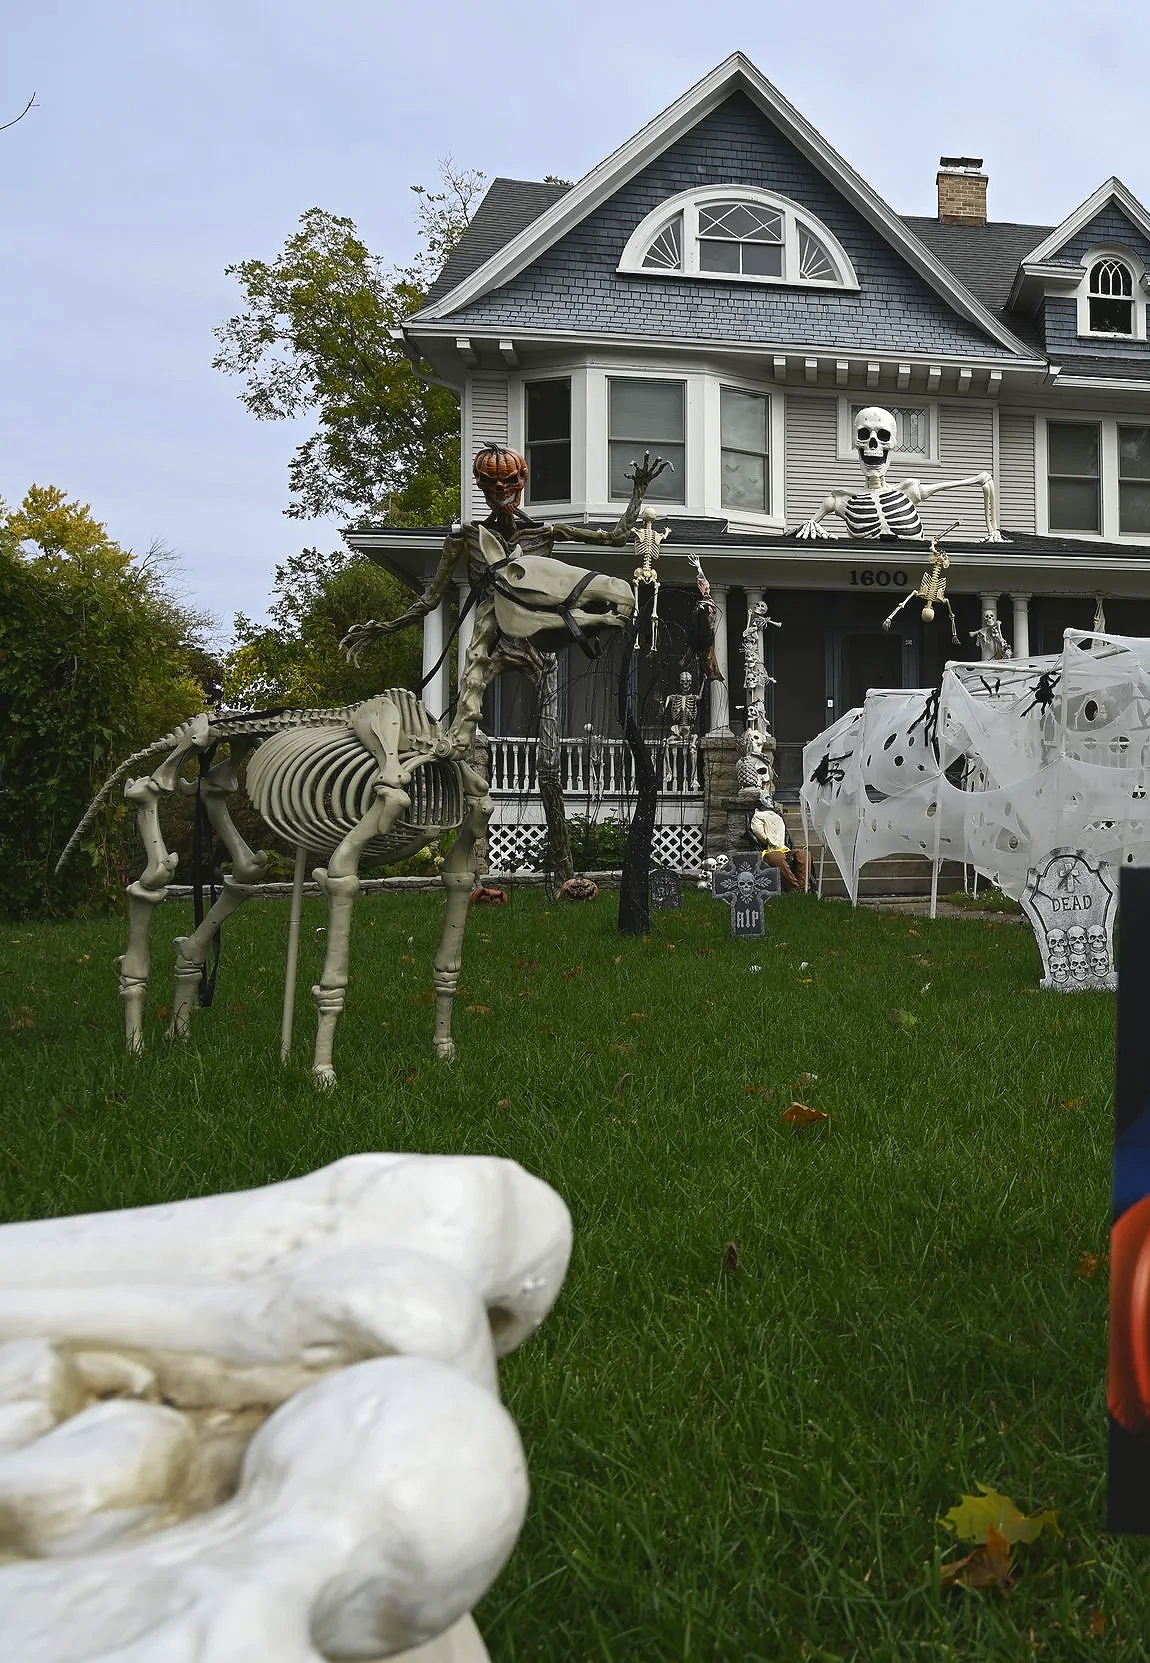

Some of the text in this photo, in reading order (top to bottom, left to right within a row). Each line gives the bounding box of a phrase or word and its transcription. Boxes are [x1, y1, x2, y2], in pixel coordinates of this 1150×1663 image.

[848, 569, 909, 587] 1600
[1050, 894, 1093, 912] DEAD
[735, 907, 760, 929] RIP
